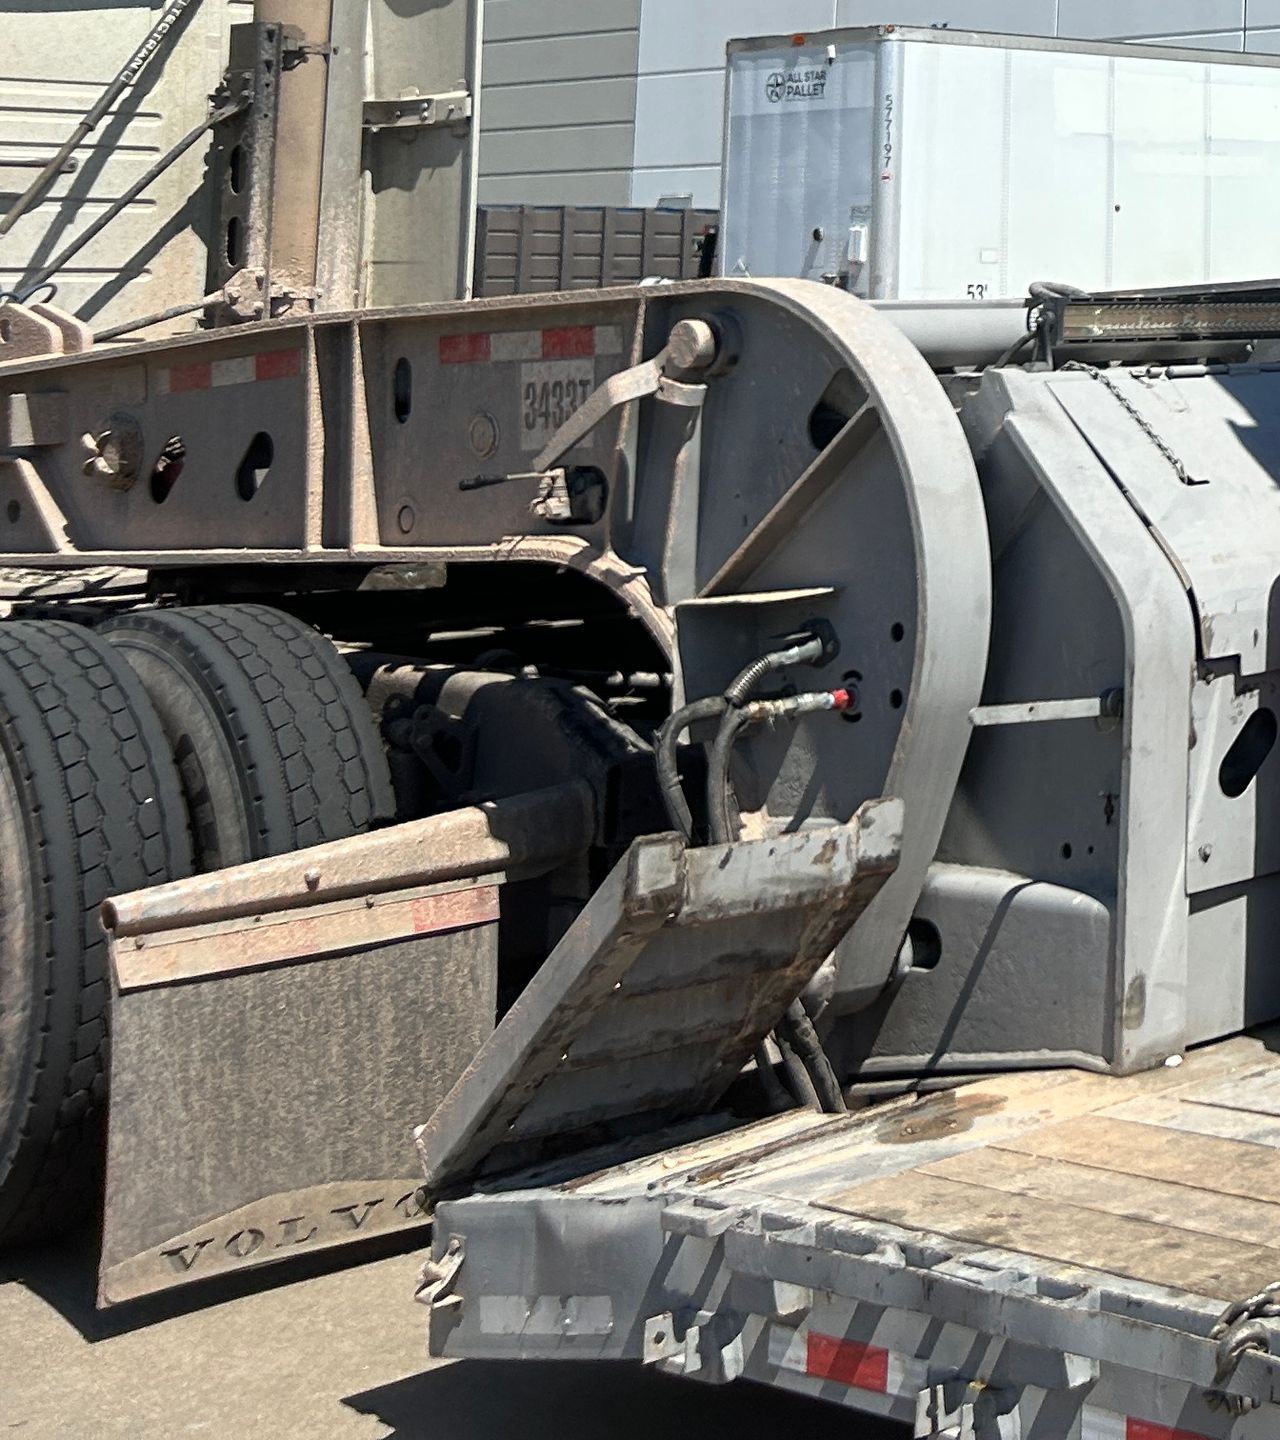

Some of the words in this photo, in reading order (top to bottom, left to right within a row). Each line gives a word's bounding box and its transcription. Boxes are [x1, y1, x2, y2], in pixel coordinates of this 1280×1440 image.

[787, 71, 803, 83] ALL
[804, 70, 827, 82] STAR
[787, 82, 825, 97] PALLET
[884, 94, 893, 168] 577197
